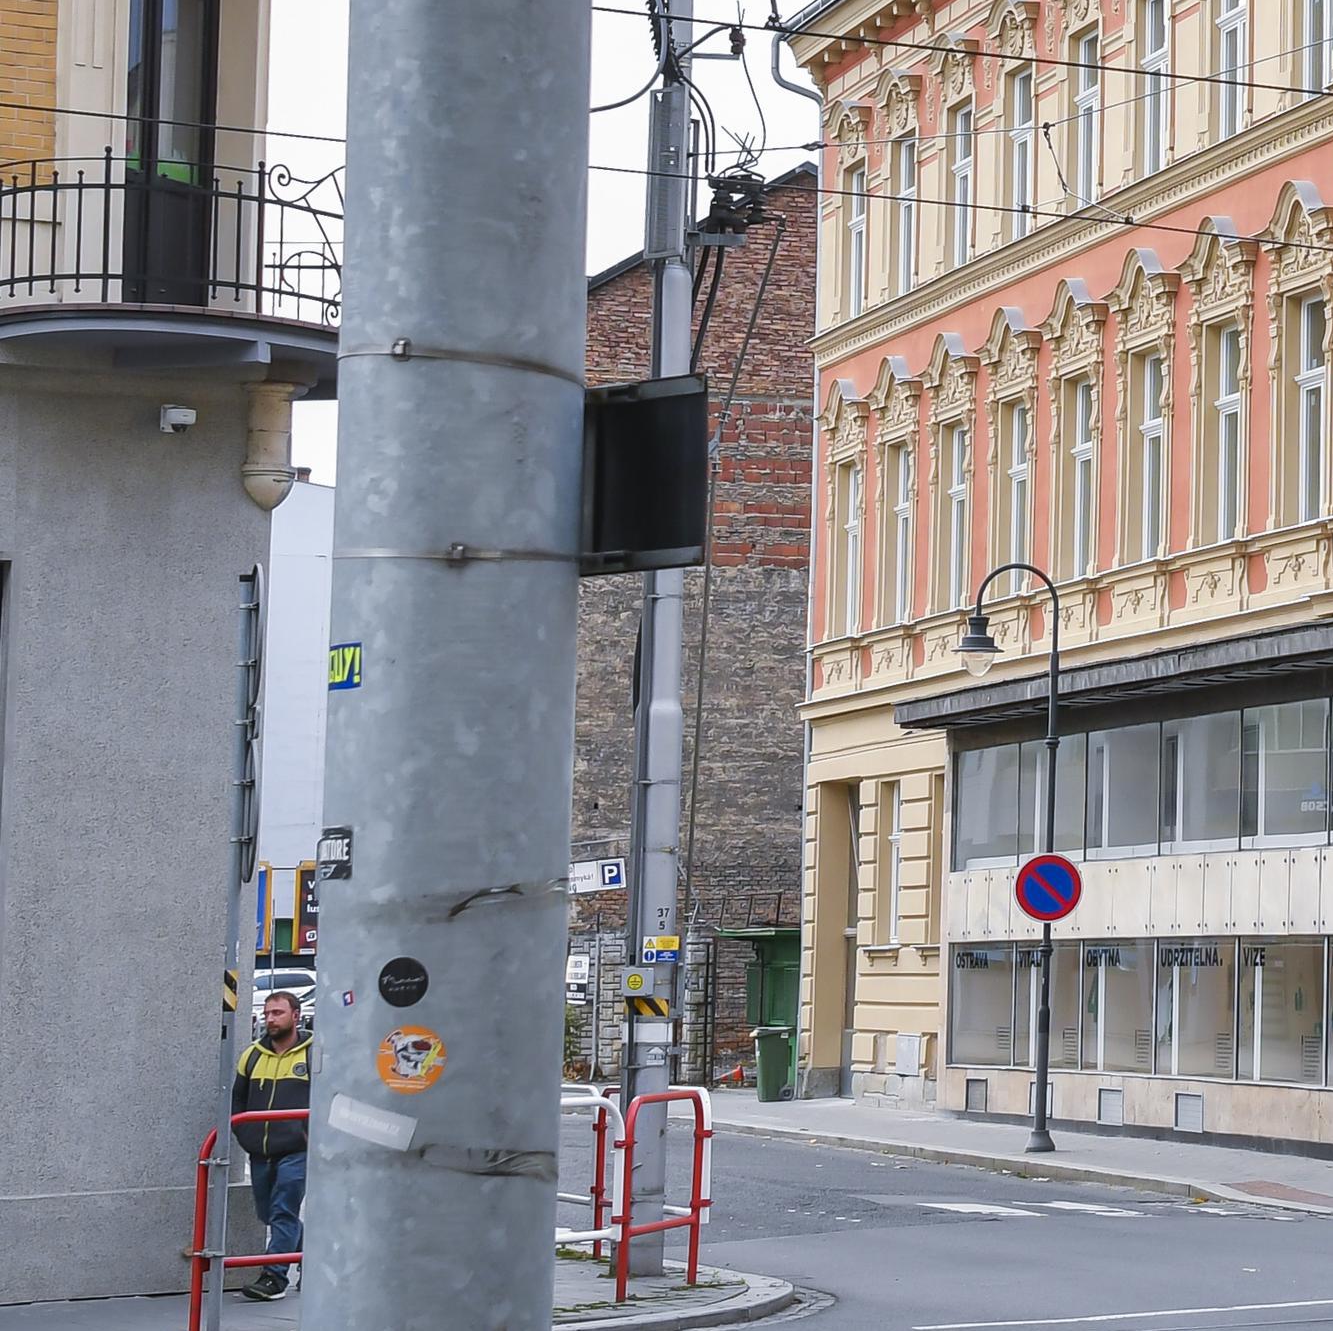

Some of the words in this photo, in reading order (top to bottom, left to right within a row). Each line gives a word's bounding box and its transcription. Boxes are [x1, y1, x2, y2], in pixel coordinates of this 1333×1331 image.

[604, 865, 618, 884] P
[657, 908, 670, 918] 37
[956, 952, 989, 969] OSTRAVA
[1086, 945, 1121, 969] OBYTNÁ
[1160, 944, 1223, 968] UDRŽITELNÁ.
[1243, 947, 1265, 967] VIZE
